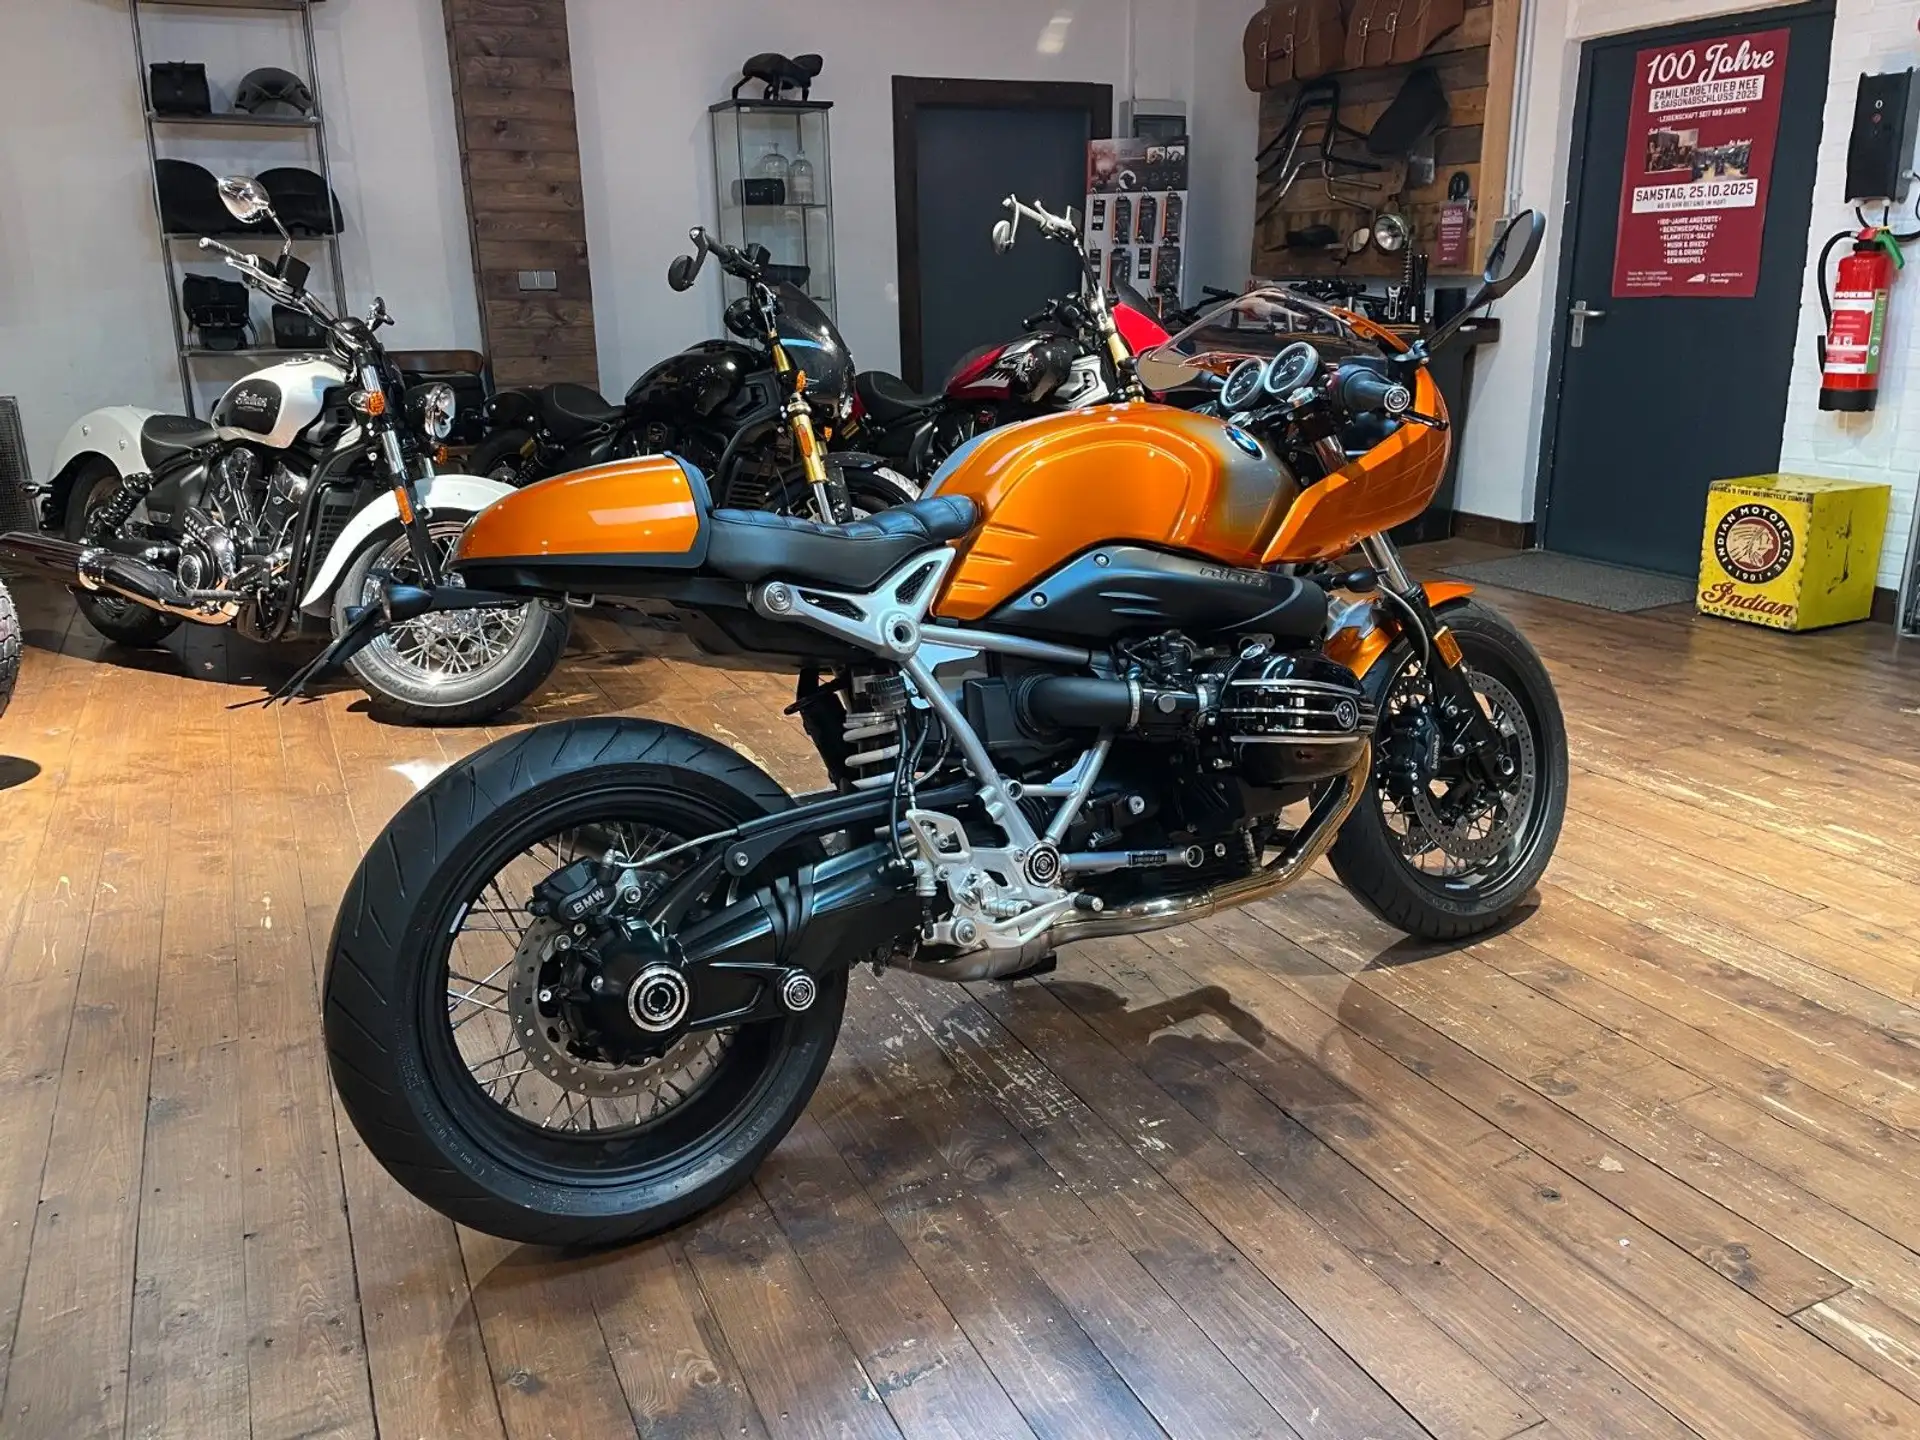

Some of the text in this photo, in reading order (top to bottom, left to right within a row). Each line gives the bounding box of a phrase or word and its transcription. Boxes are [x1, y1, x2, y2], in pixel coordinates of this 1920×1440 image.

[1647, 40, 1774, 84] 100 Jahre
[1653, 89, 1758, 109] & SAISONABSCHLUSS 2025
[1654, 78, 1759, 100] FAMILIENBETRIEB NEE
[1636, 182, 1754, 202] SAMSTAG, 25.10.2025
[1717, 506, 1792, 572] INDIAN MOTORCYCLE
[1735, 570, 1763, 581] 1901
[1701, 581, 1793, 617] Indian
[572, 887, 606, 915] BMW
